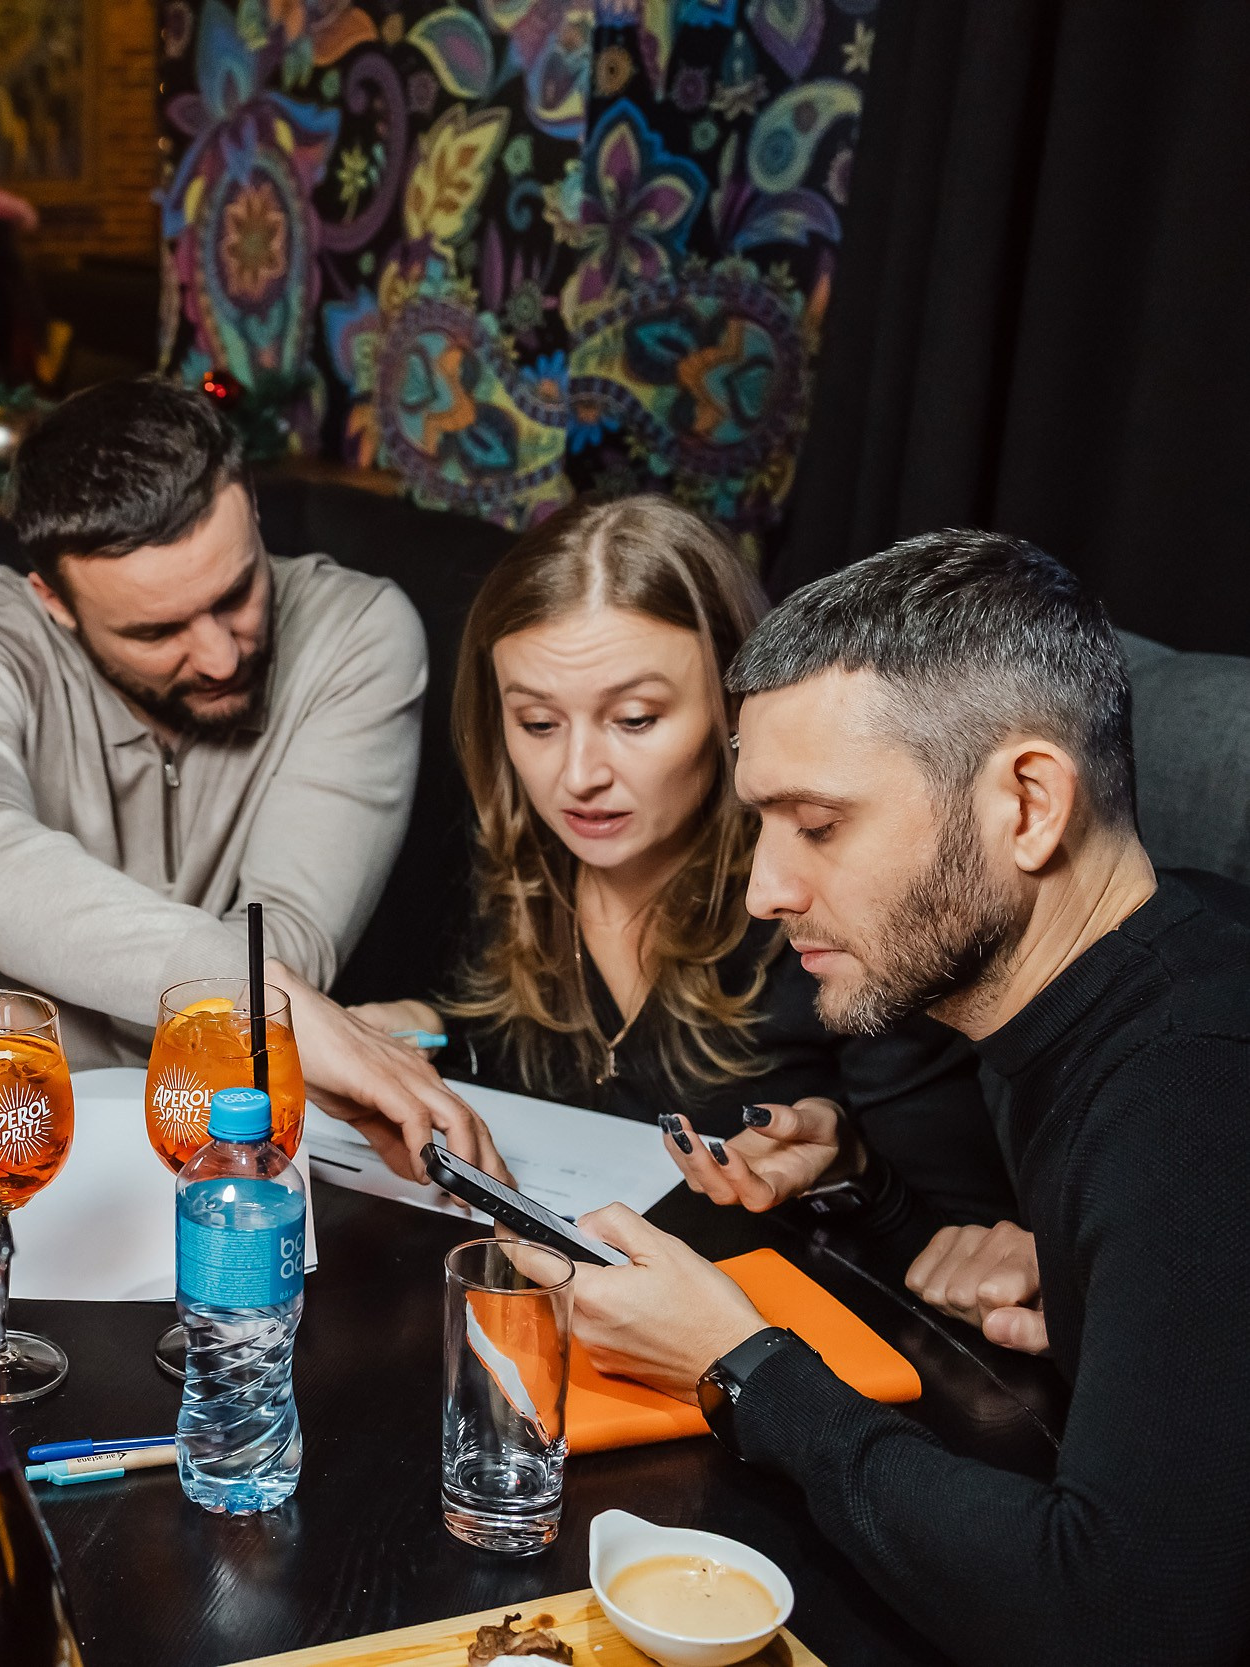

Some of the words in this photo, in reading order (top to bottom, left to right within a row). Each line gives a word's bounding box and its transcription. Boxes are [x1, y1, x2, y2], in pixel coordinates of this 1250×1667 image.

[152, 1084, 212, 1110] APEROL
[76, 1455, 103, 1463] astana
[105, 1453, 116, 1461] air
